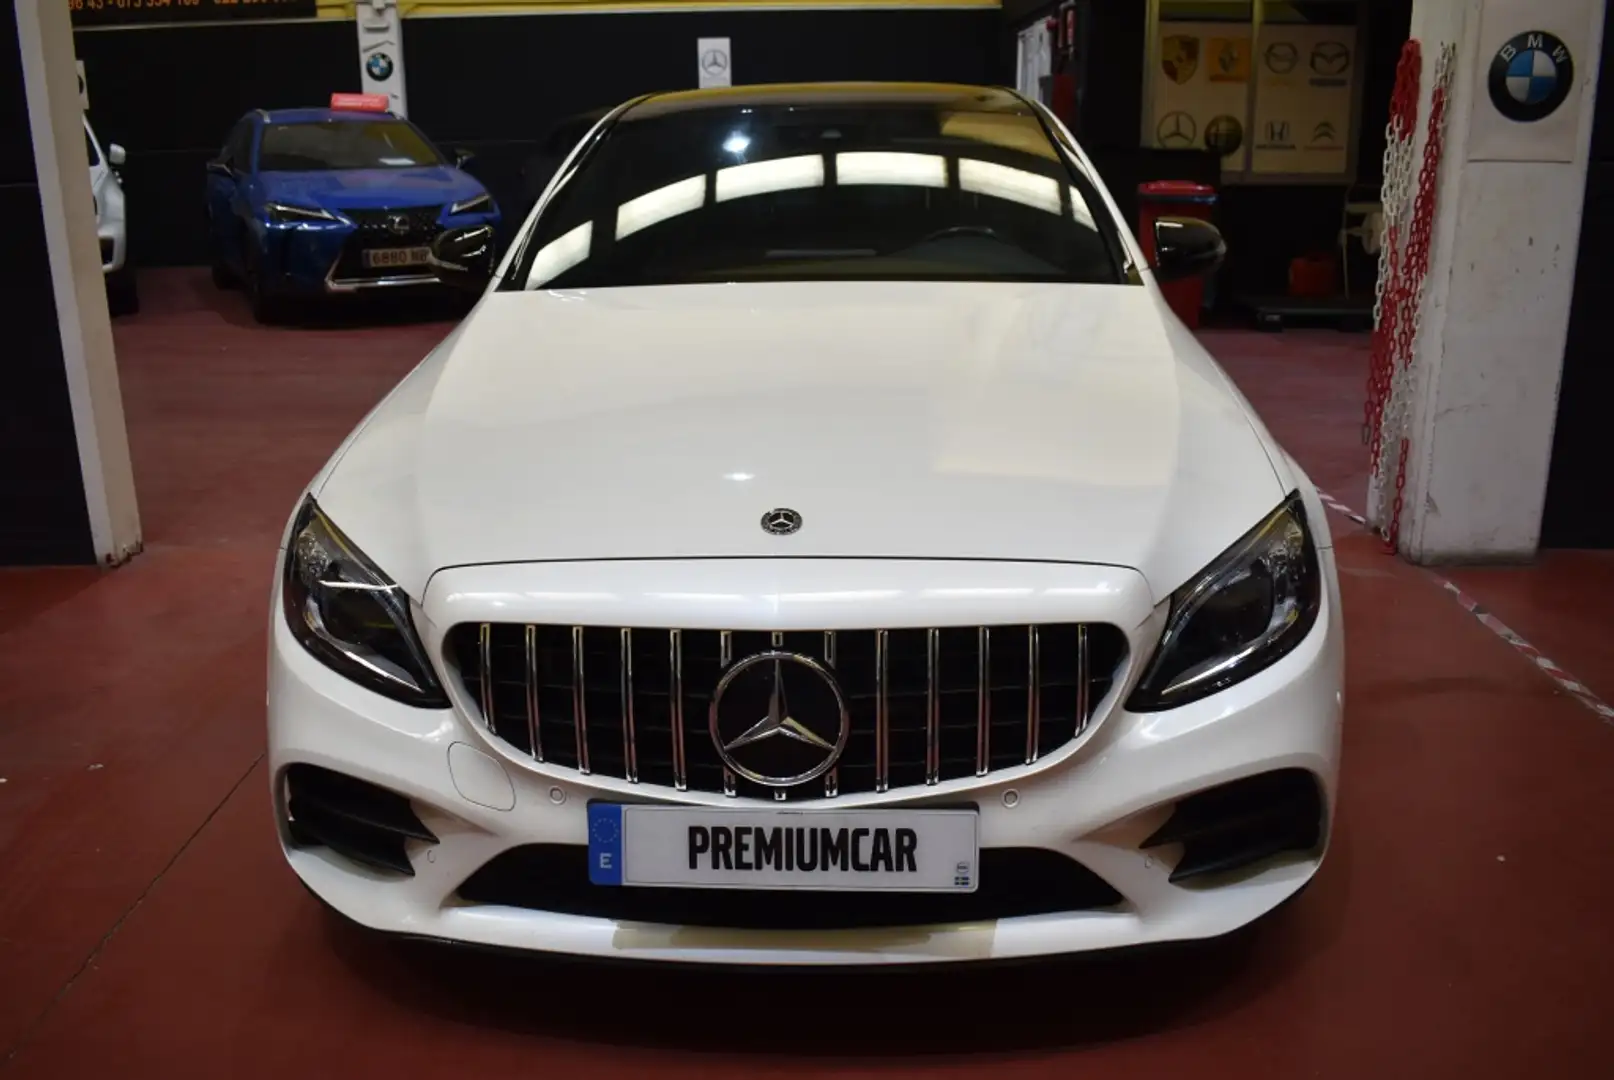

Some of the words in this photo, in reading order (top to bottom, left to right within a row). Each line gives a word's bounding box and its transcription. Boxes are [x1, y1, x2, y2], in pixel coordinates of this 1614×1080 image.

[1500, 34, 1568, 64] BMW
[600, 853, 612, 869] E
[688, 825, 918, 873] PREMIUMCAR
